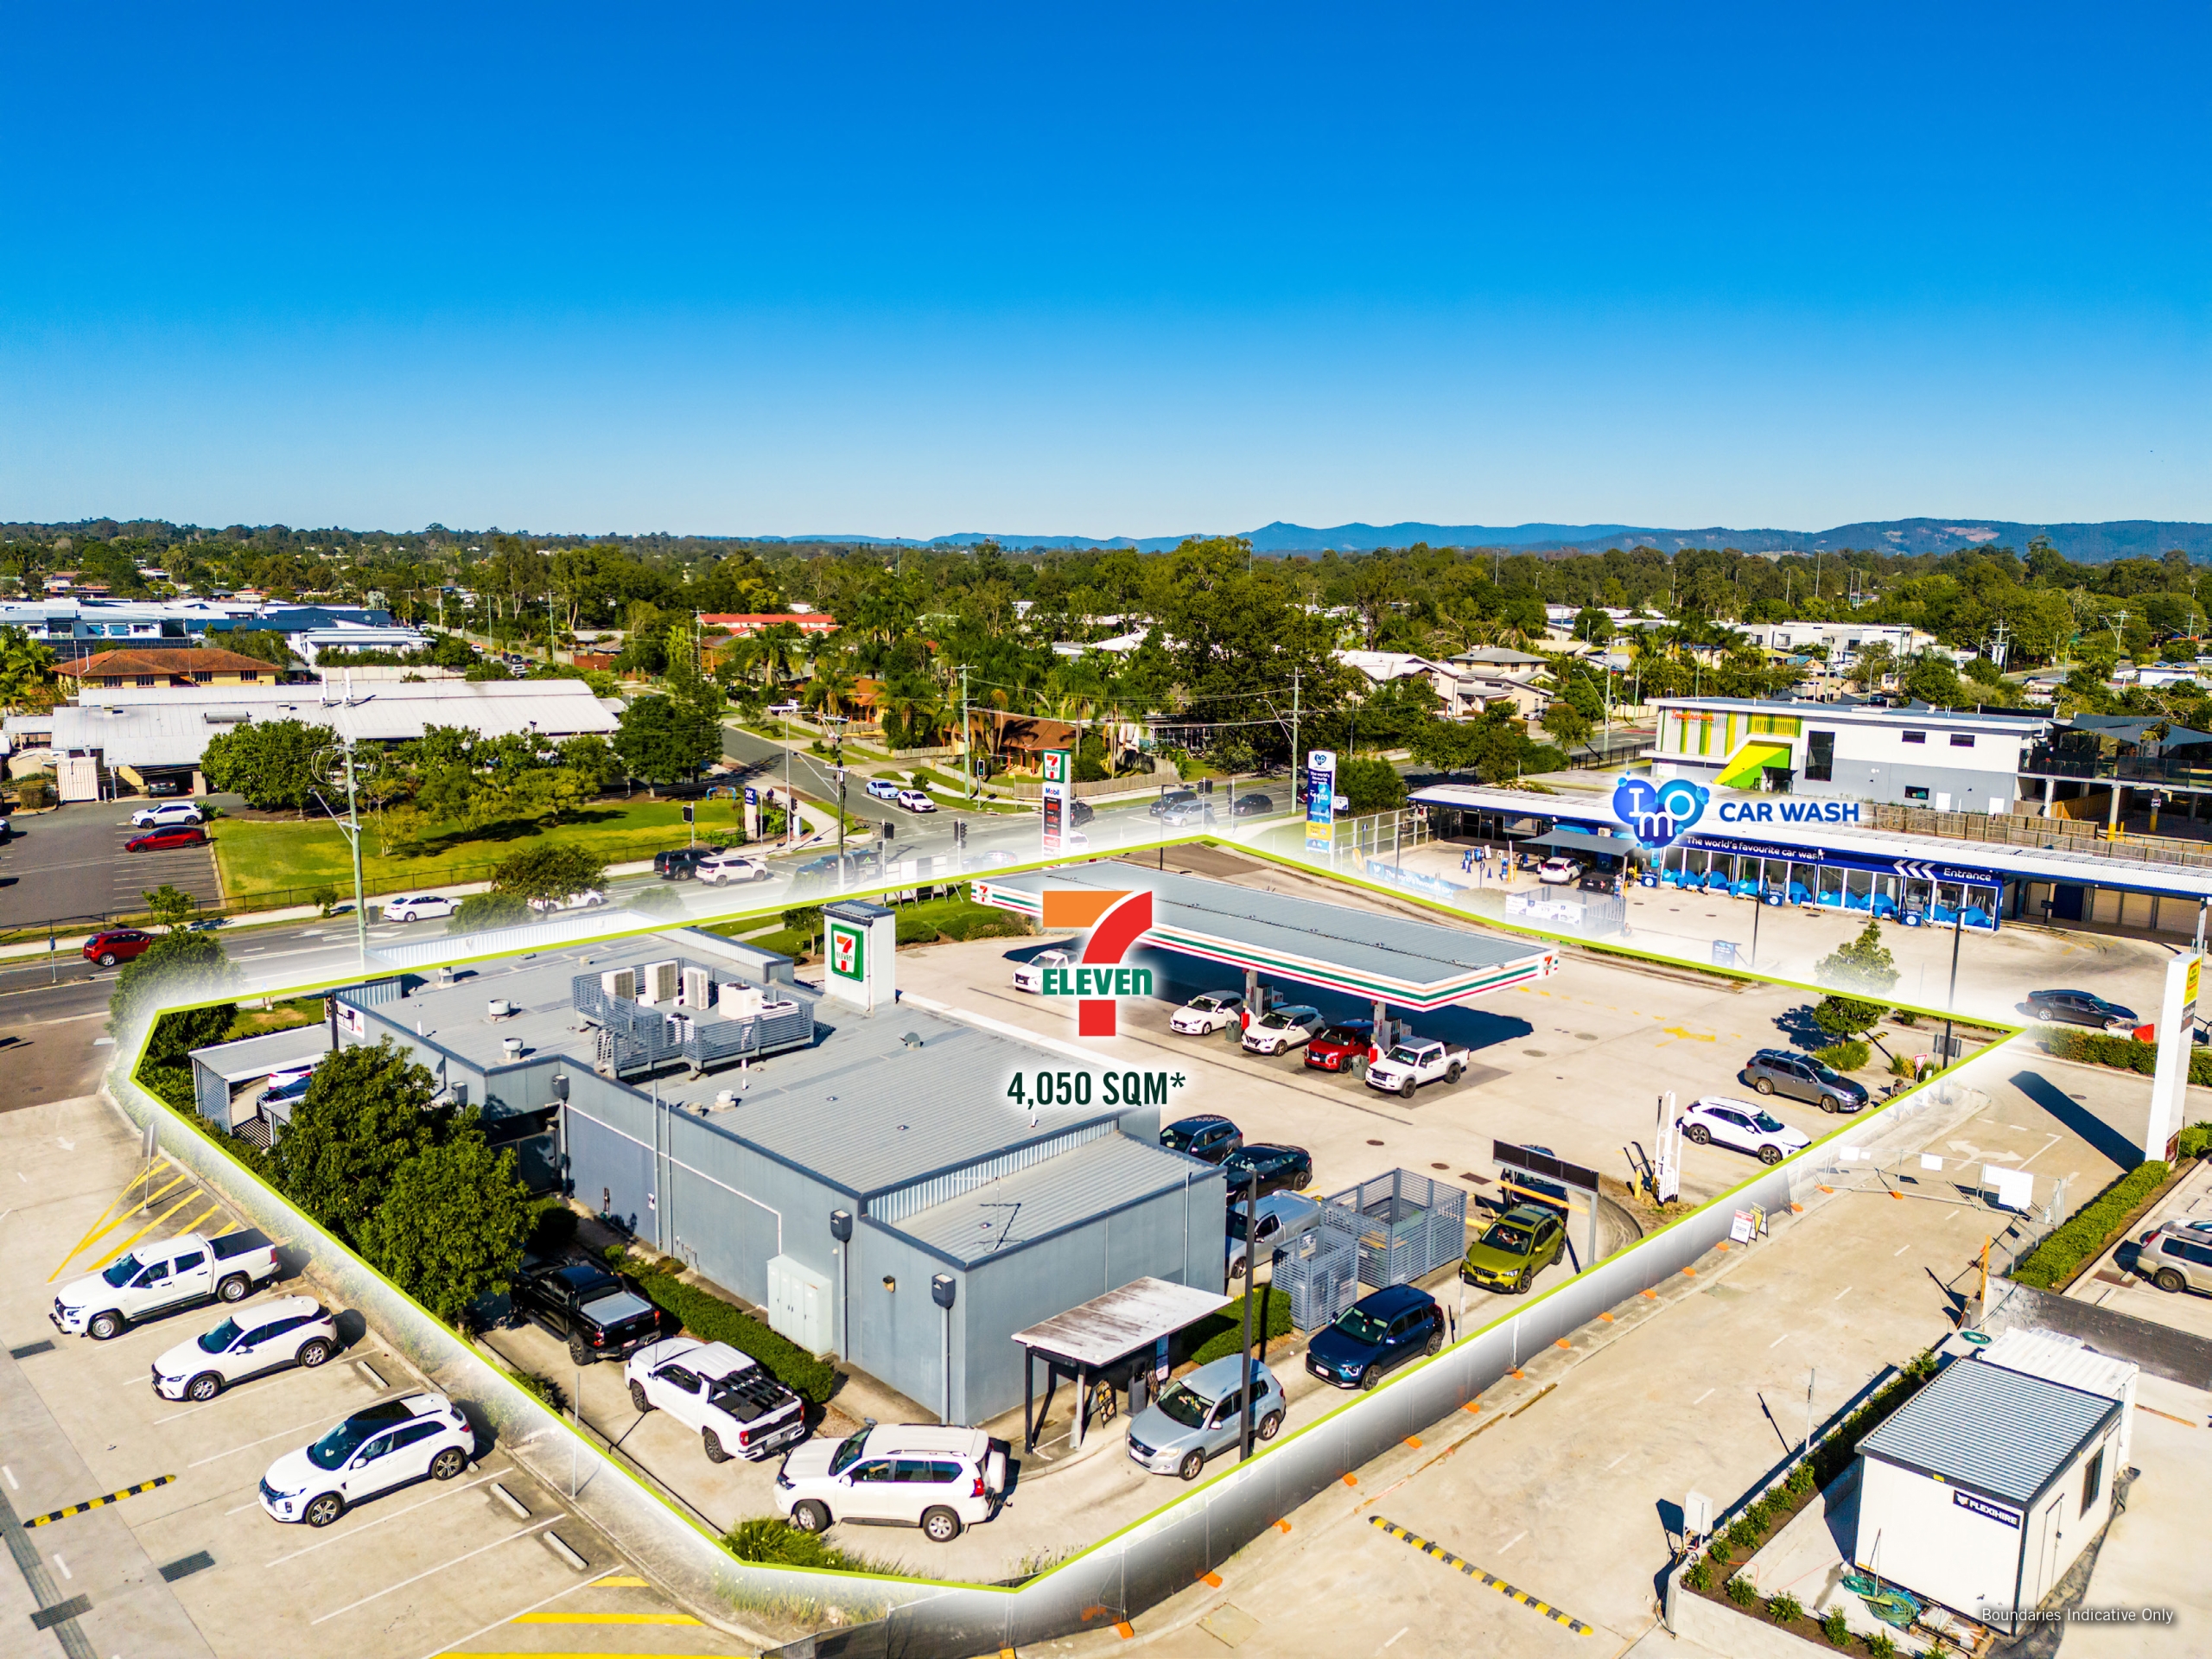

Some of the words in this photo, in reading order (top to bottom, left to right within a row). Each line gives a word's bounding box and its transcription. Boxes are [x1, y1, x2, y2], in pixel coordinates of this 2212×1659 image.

[1046, 754, 1058, 779] 7
[1687, 836, 1702, 846] The
[1704, 838, 1738, 849] world's
[1738, 842, 1780, 855] favourite
[1781, 849, 1797, 857] car
[1798, 849, 1824, 861] wash
[1943, 868, 1992, 881] Entrance
[836, 935, 853, 971] 7
[1969, 1499, 2018, 1525] FLEXIHIRE
